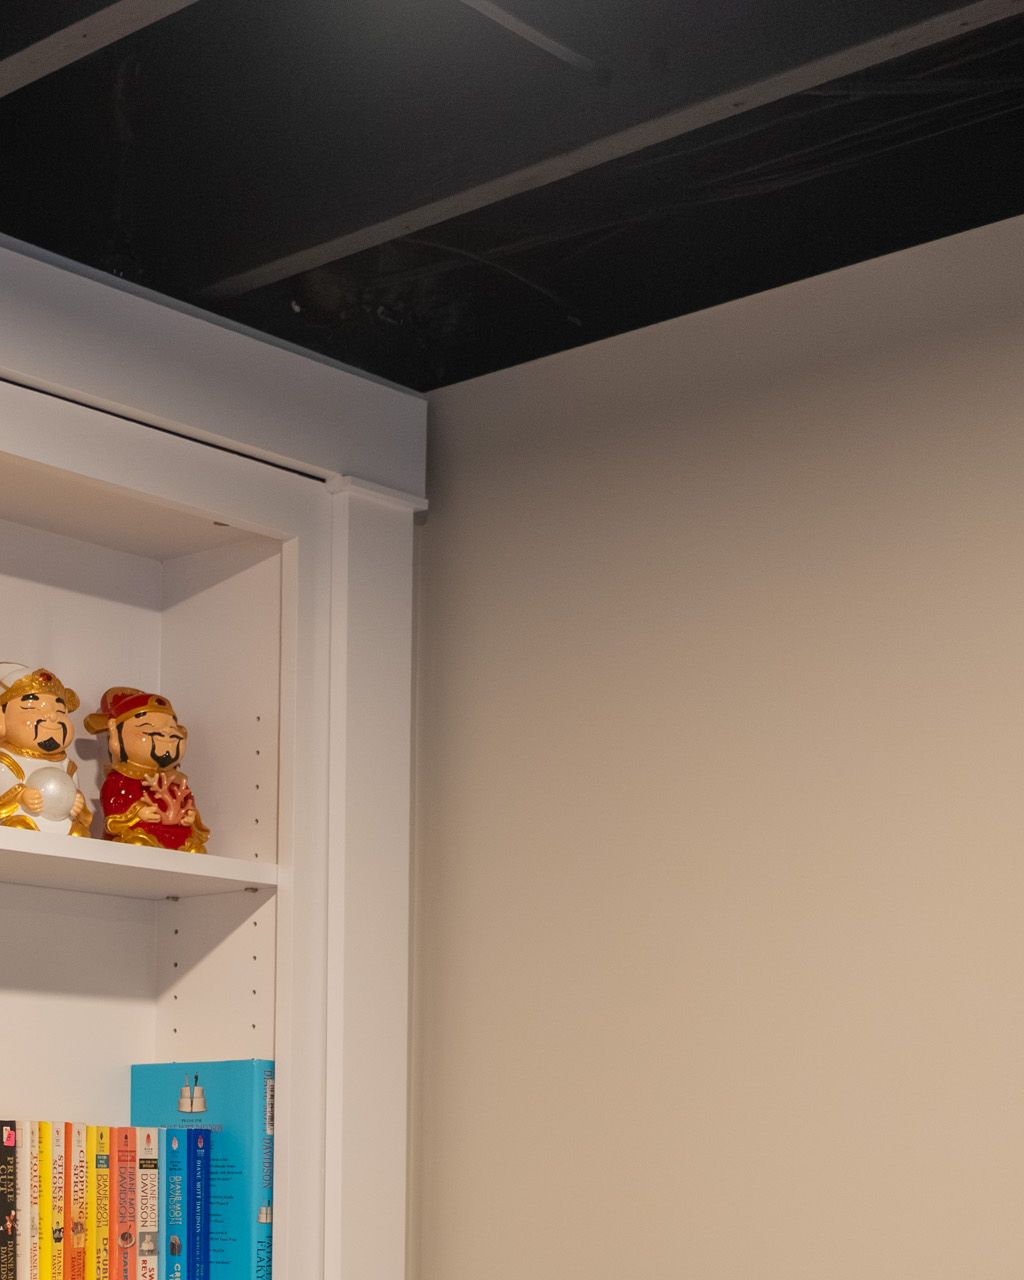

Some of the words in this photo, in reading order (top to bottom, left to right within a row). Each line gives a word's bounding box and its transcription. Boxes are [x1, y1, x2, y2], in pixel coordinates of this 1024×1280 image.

[0, 1165, 7, 1193] CUT
[263, 1138, 272, 1189] DAVIDSON
[119, 1166, 127, 1224] DAVIDSON
[141, 1174, 149, 1227] DAVIDSON
[169, 1176, 177, 1225] DAVIDSON
[256, 1240, 266, 1280] FLAKY
